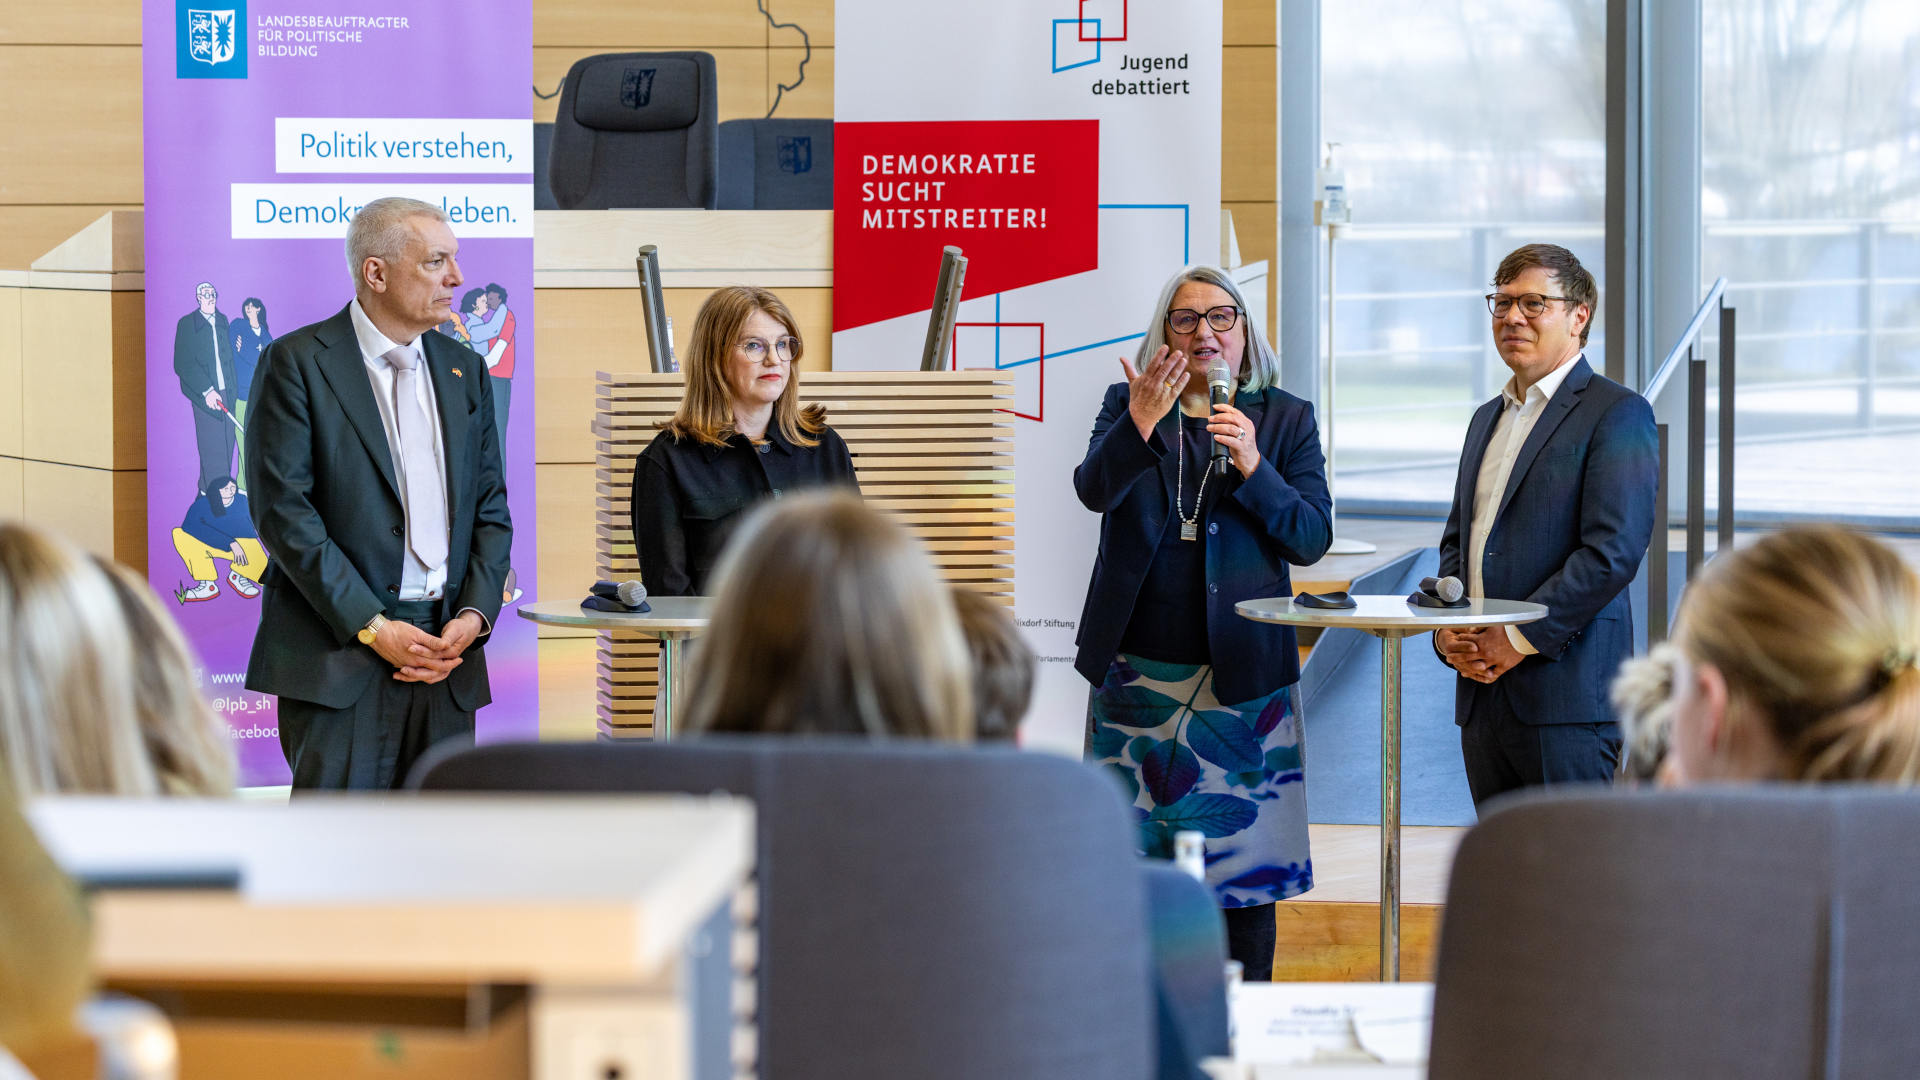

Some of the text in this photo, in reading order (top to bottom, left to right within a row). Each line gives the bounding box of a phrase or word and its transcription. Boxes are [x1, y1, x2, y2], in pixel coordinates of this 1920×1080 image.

[258, 15, 409, 29] LANDESBEAUFTRAGTER
[258, 29, 363, 43] FÜR POLITISCHE
[258, 45, 318, 57] BILDUNG
[1120, 53, 1189, 74] Jugend
[1092, 77, 1190, 96] debattiert
[301, 131, 513, 162] Politik verstehen,
[863, 154, 1036, 175] DEMOKRATIE
[862, 182, 946, 203] SUCHT
[256, 196, 517, 224] Demokr leben.
[862, 208, 1047, 229] MITSTREITER!
[1044, 619, 1075, 629] Stiftung
[212, 673, 246, 684] www
[212, 696, 271, 715] @lpb_sh
[226, 723, 279, 739] faceboo
